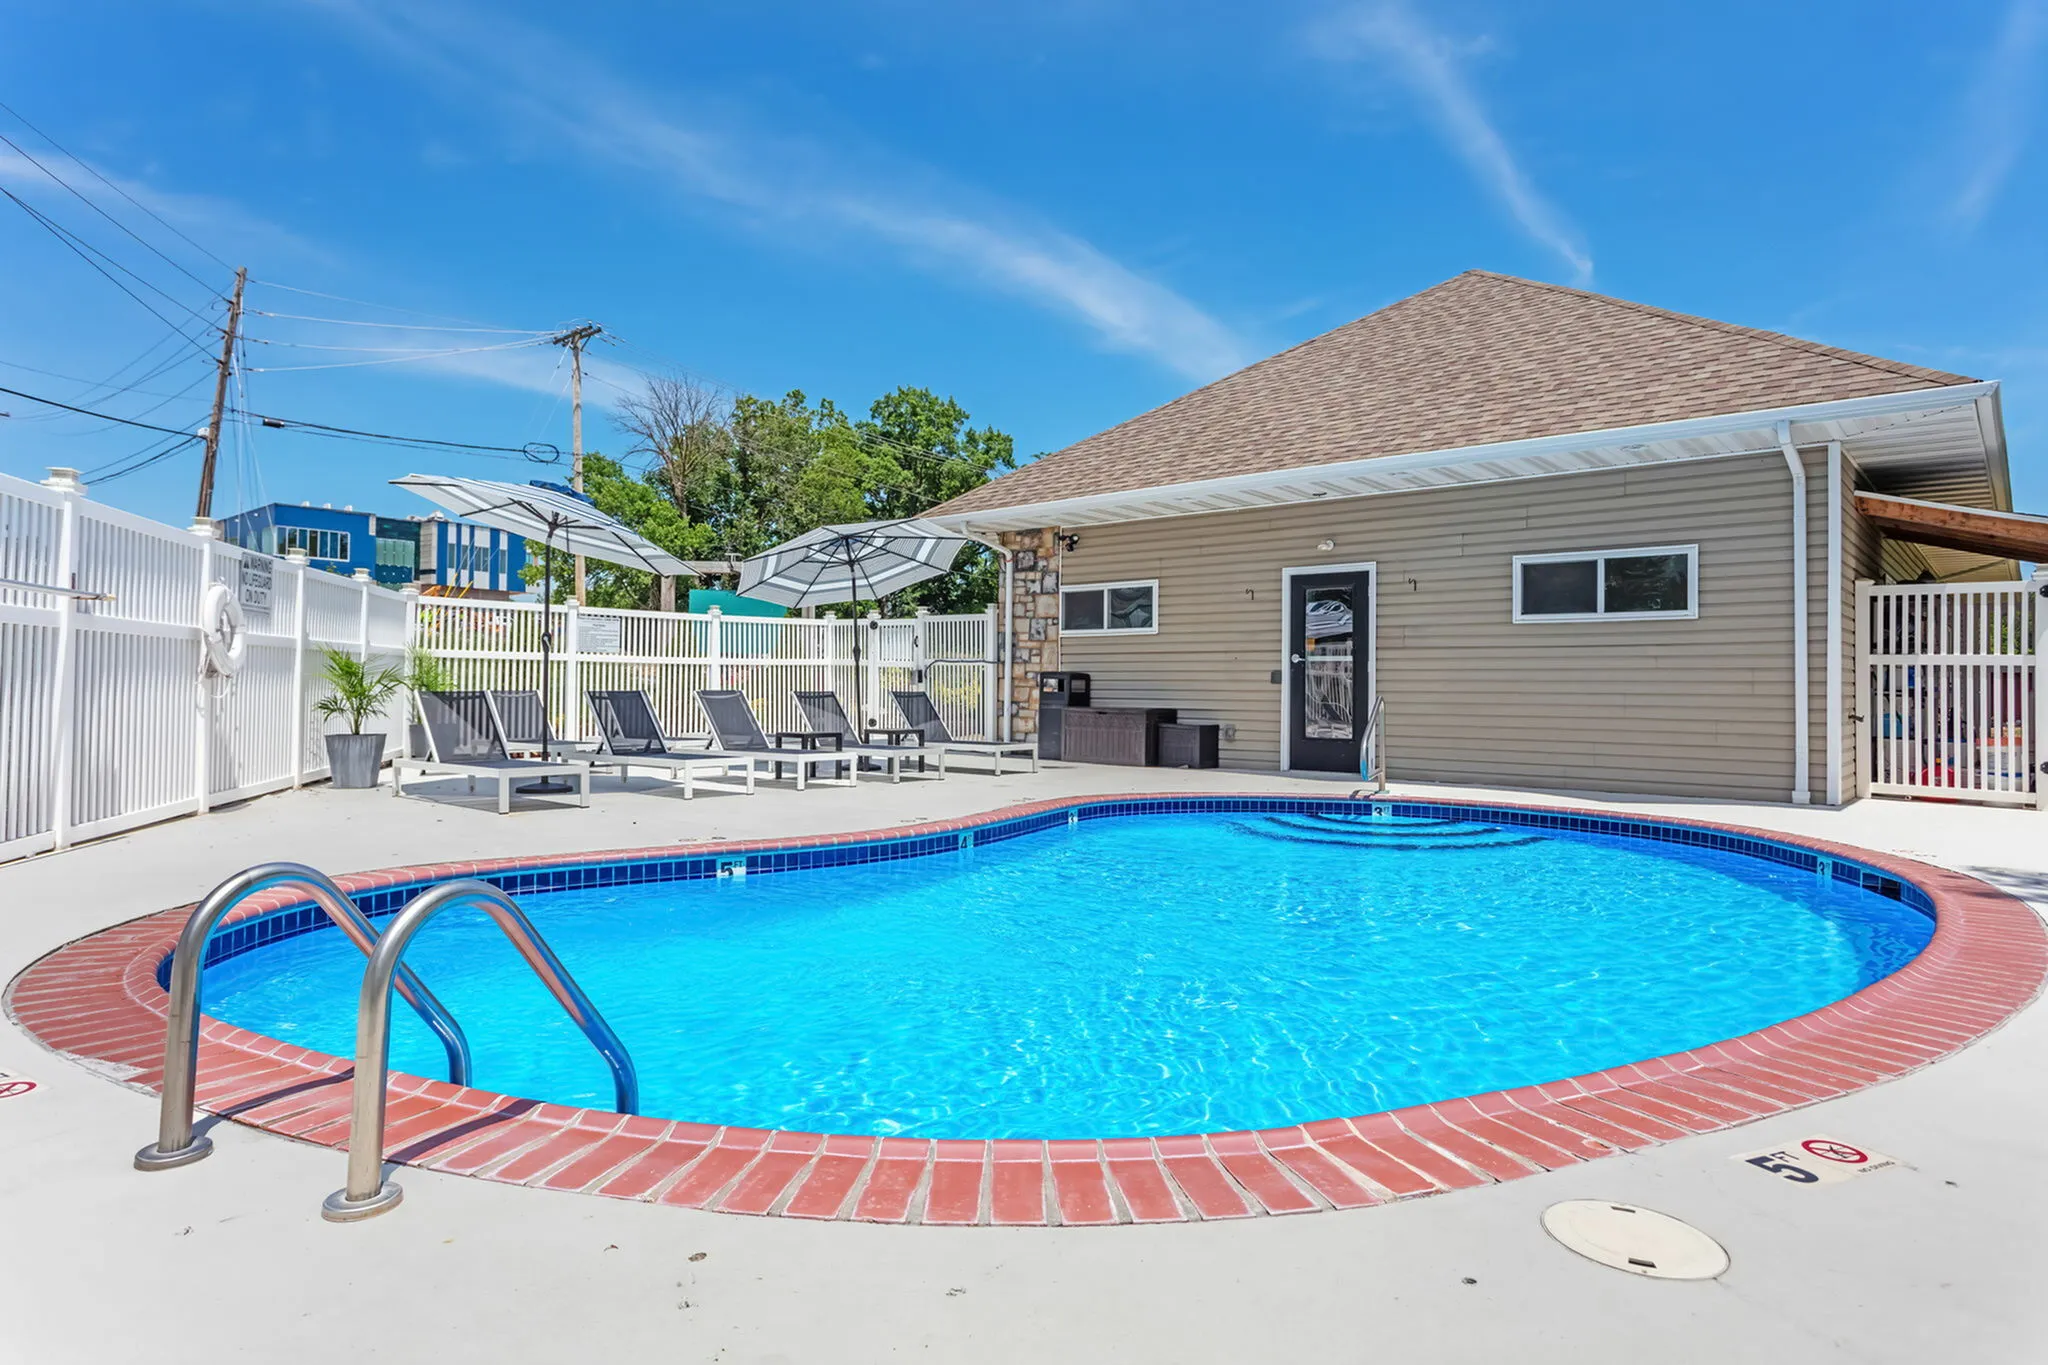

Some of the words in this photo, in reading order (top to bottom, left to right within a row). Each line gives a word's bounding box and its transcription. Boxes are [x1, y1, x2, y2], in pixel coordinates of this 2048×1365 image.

[250, 555, 272, 574] WARNING
[241, 571, 250, 586] NO
[249, 573, 272, 590] LIFEGUARD
[245, 588, 253, 603] ON
[253, 590, 268, 605] DUTY
[960, 835, 968, 848] 4
[720, 861, 734, 877] 5
[733, 860, 743, 868] FT
[1769, 1151, 1800, 1163] FT
[1745, 1156, 1819, 1183] 5
